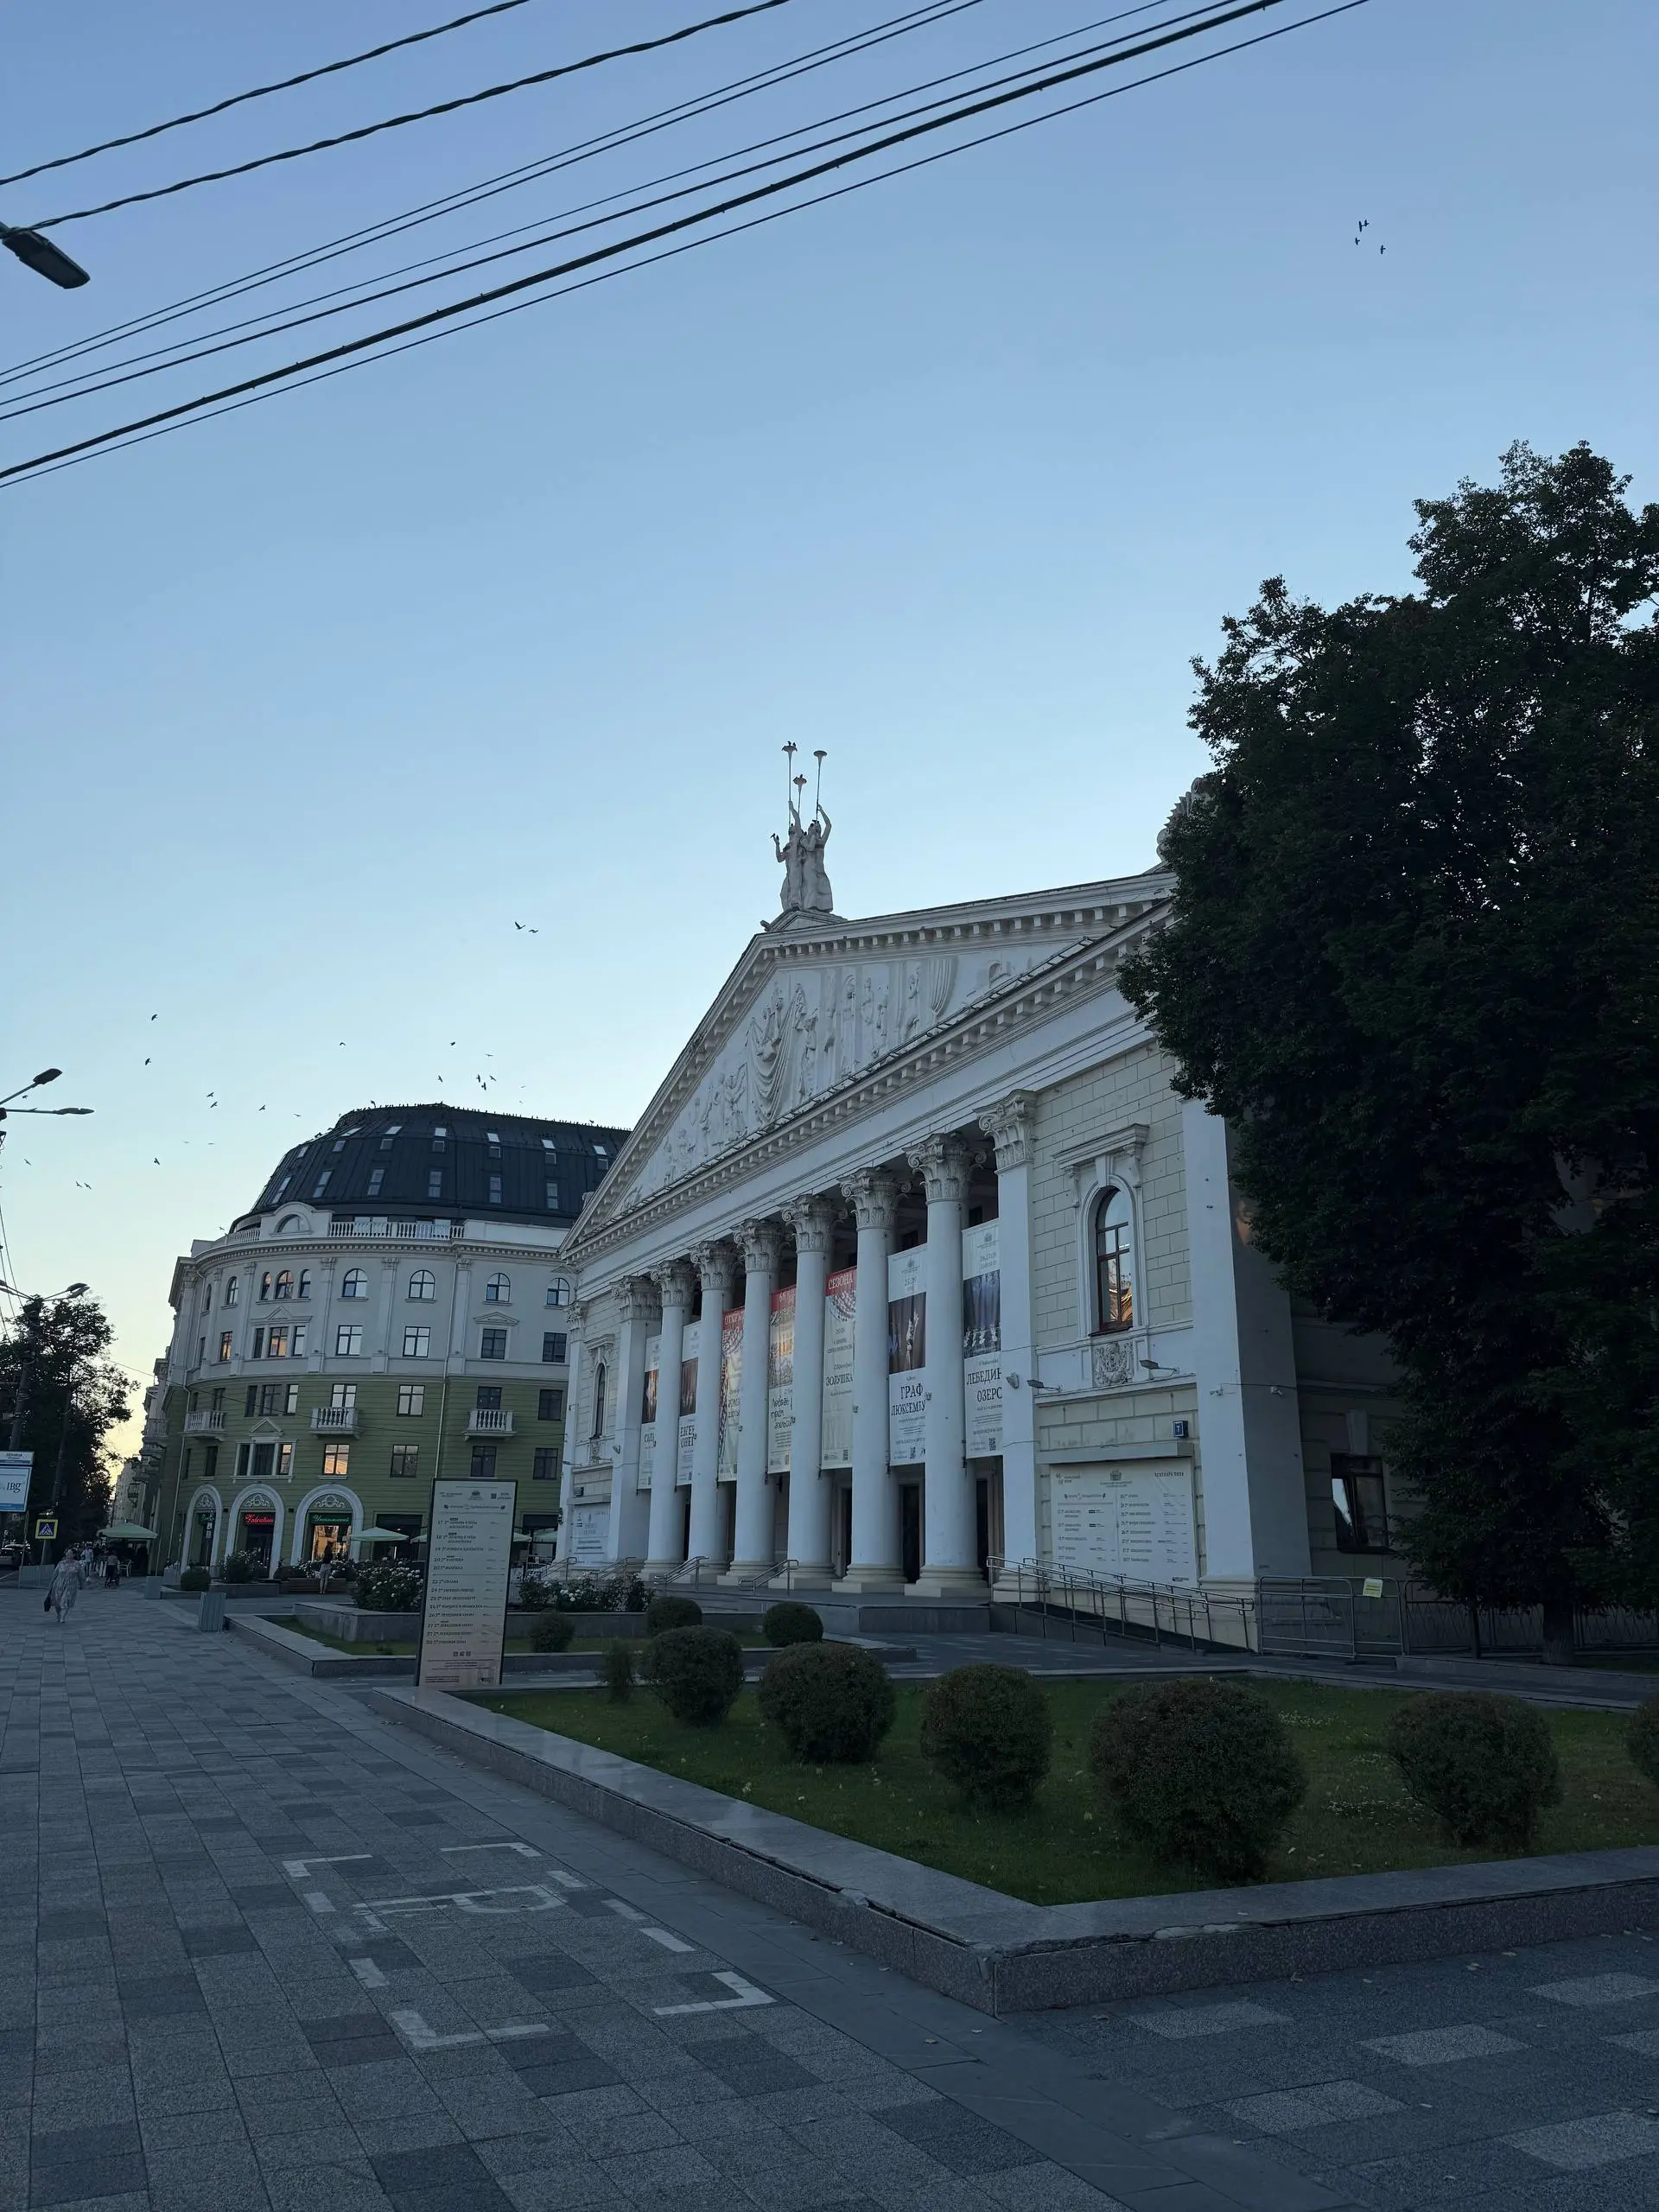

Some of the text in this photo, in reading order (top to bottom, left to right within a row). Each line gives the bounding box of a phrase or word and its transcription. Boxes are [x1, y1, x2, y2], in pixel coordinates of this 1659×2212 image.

[827, 1273, 853, 1289] СЕЗОНА
[825, 1373, 854, 1387] ЗОЛУШКА
[900, 1383, 923, 1400] ГРАФ
